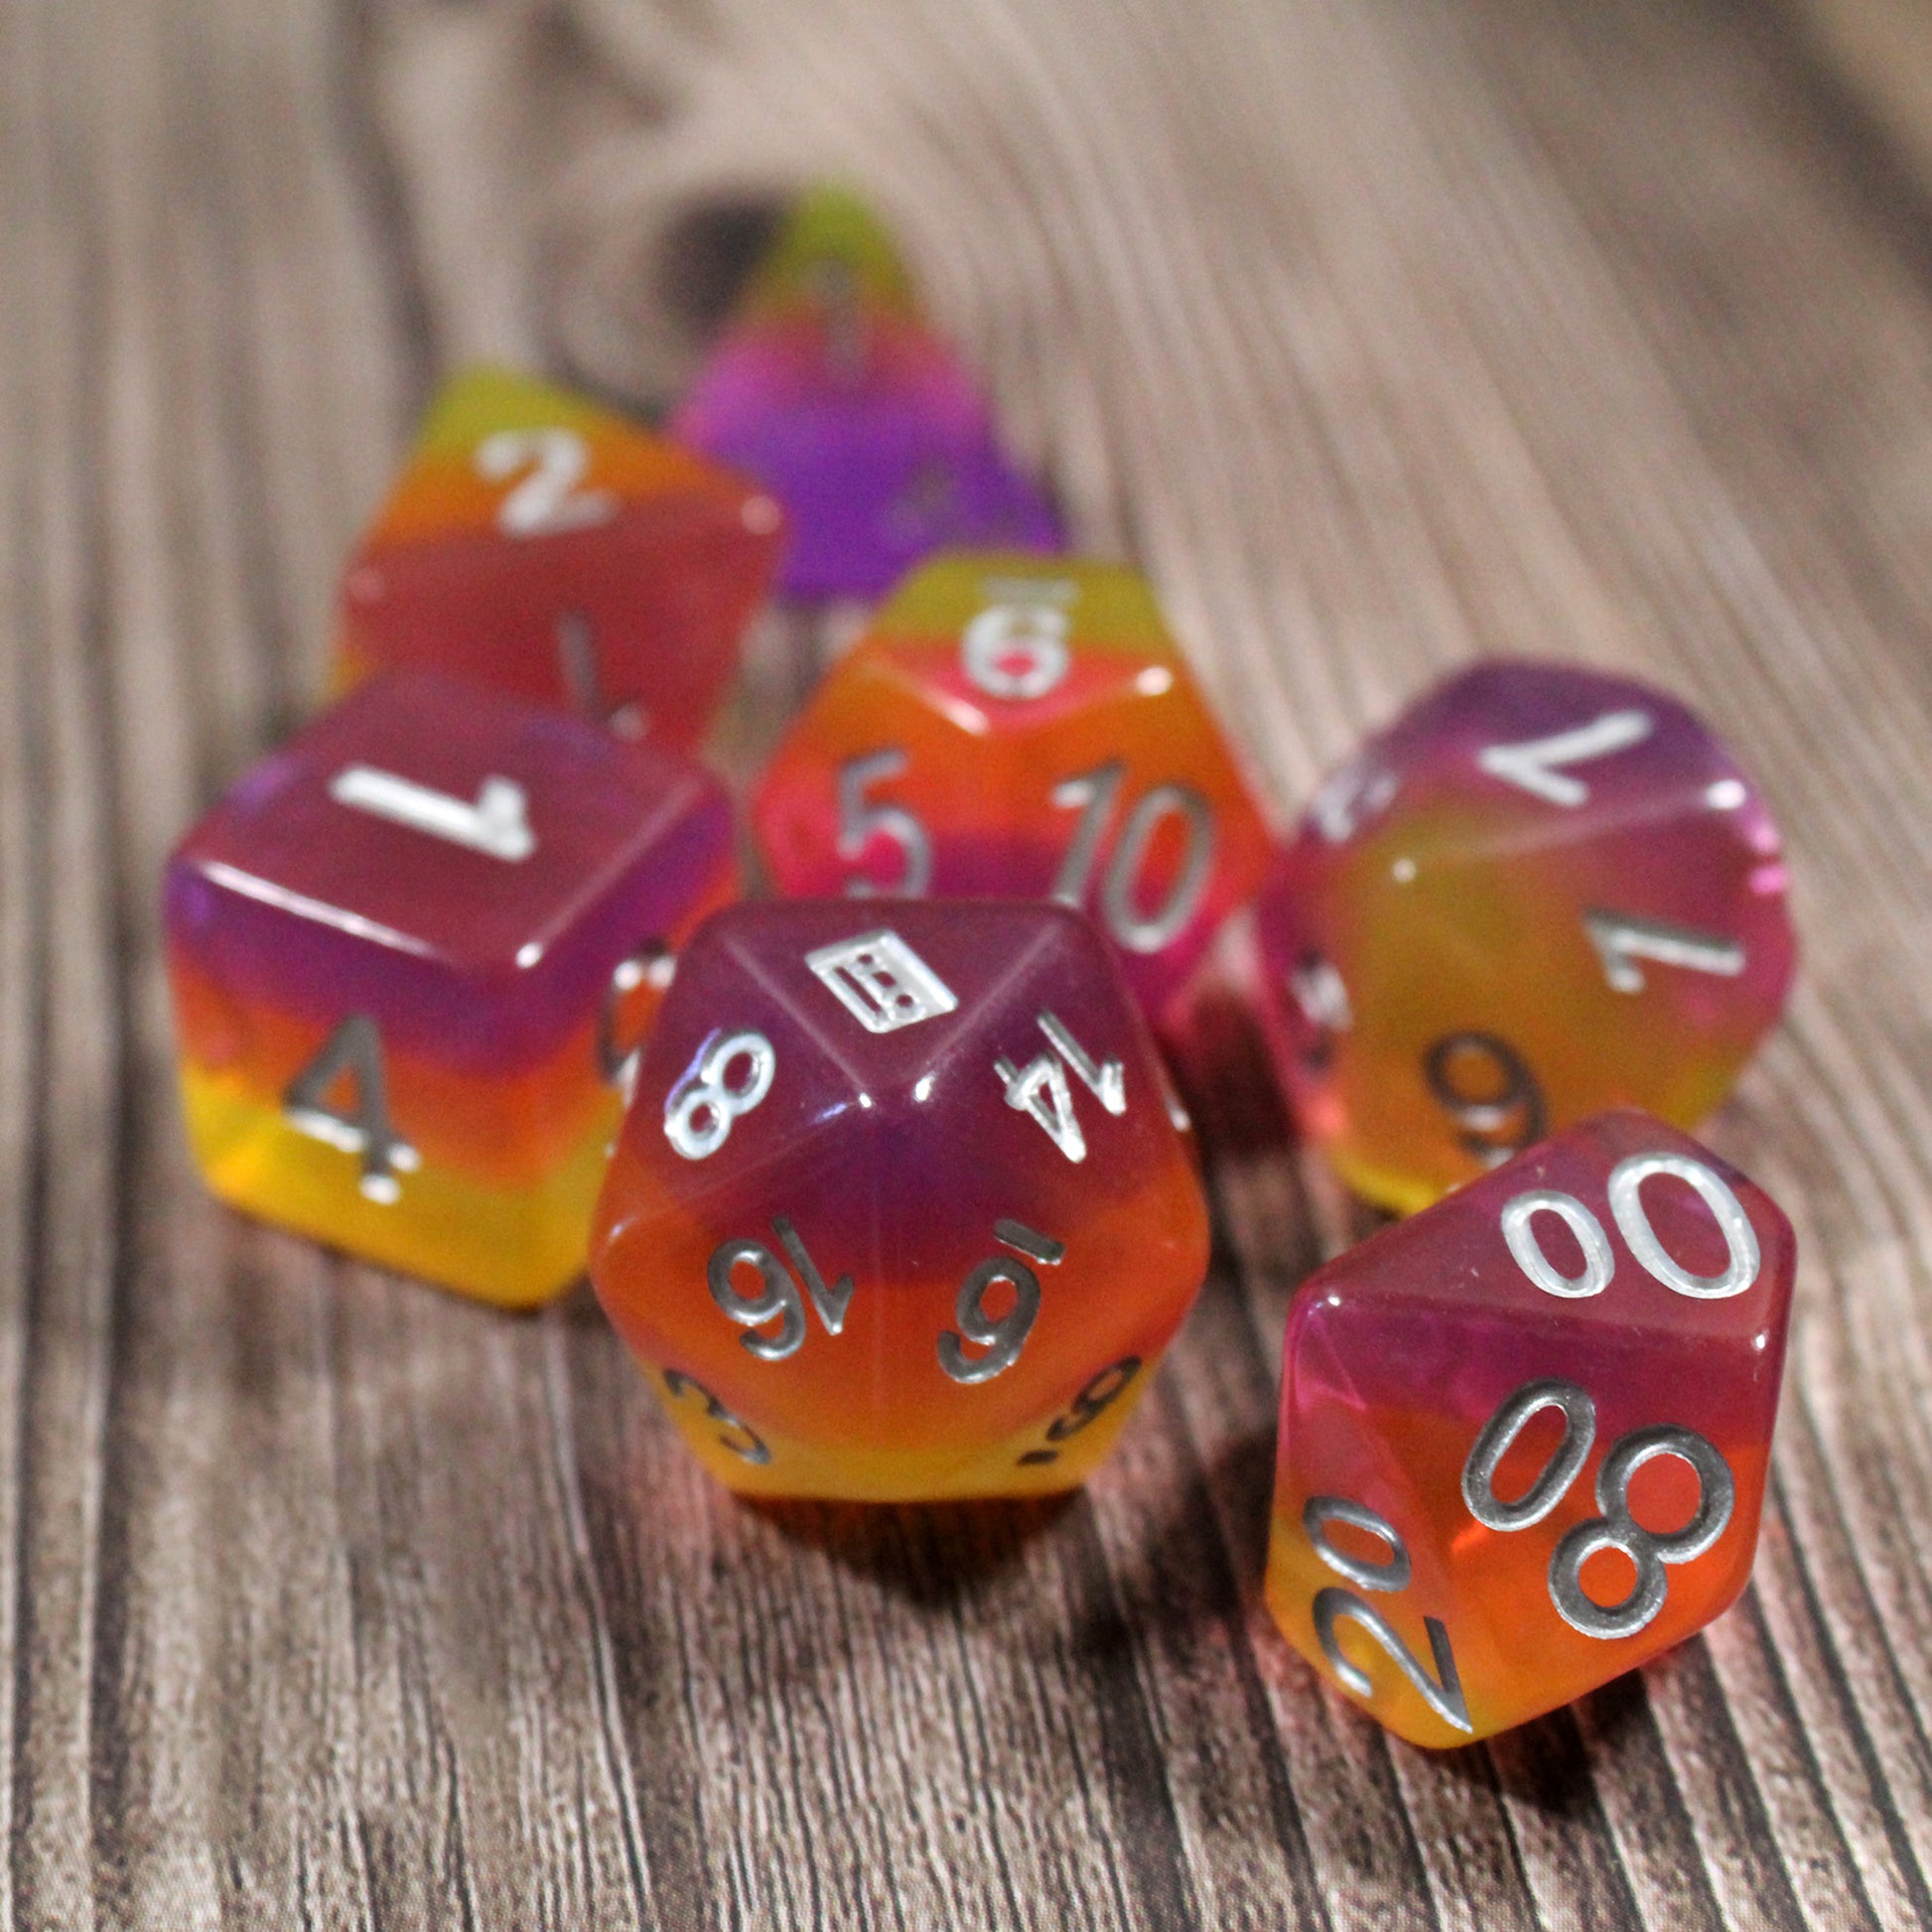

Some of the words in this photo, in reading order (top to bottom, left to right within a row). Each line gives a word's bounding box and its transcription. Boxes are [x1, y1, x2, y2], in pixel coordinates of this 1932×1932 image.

[477, 427, 618, 537] 2
[327, 762, 536, 862] 1
[836, 746, 931, 899] 5
[1050, 757, 1215, 953] 10
[281, 1013, 422, 1205] 4
[664, 1029, 775, 1161] 8
[994, 1008, 1126, 1163] 14
[706, 1214, 855, 1361] 16
[1501, 1152, 1760, 1300] 00
